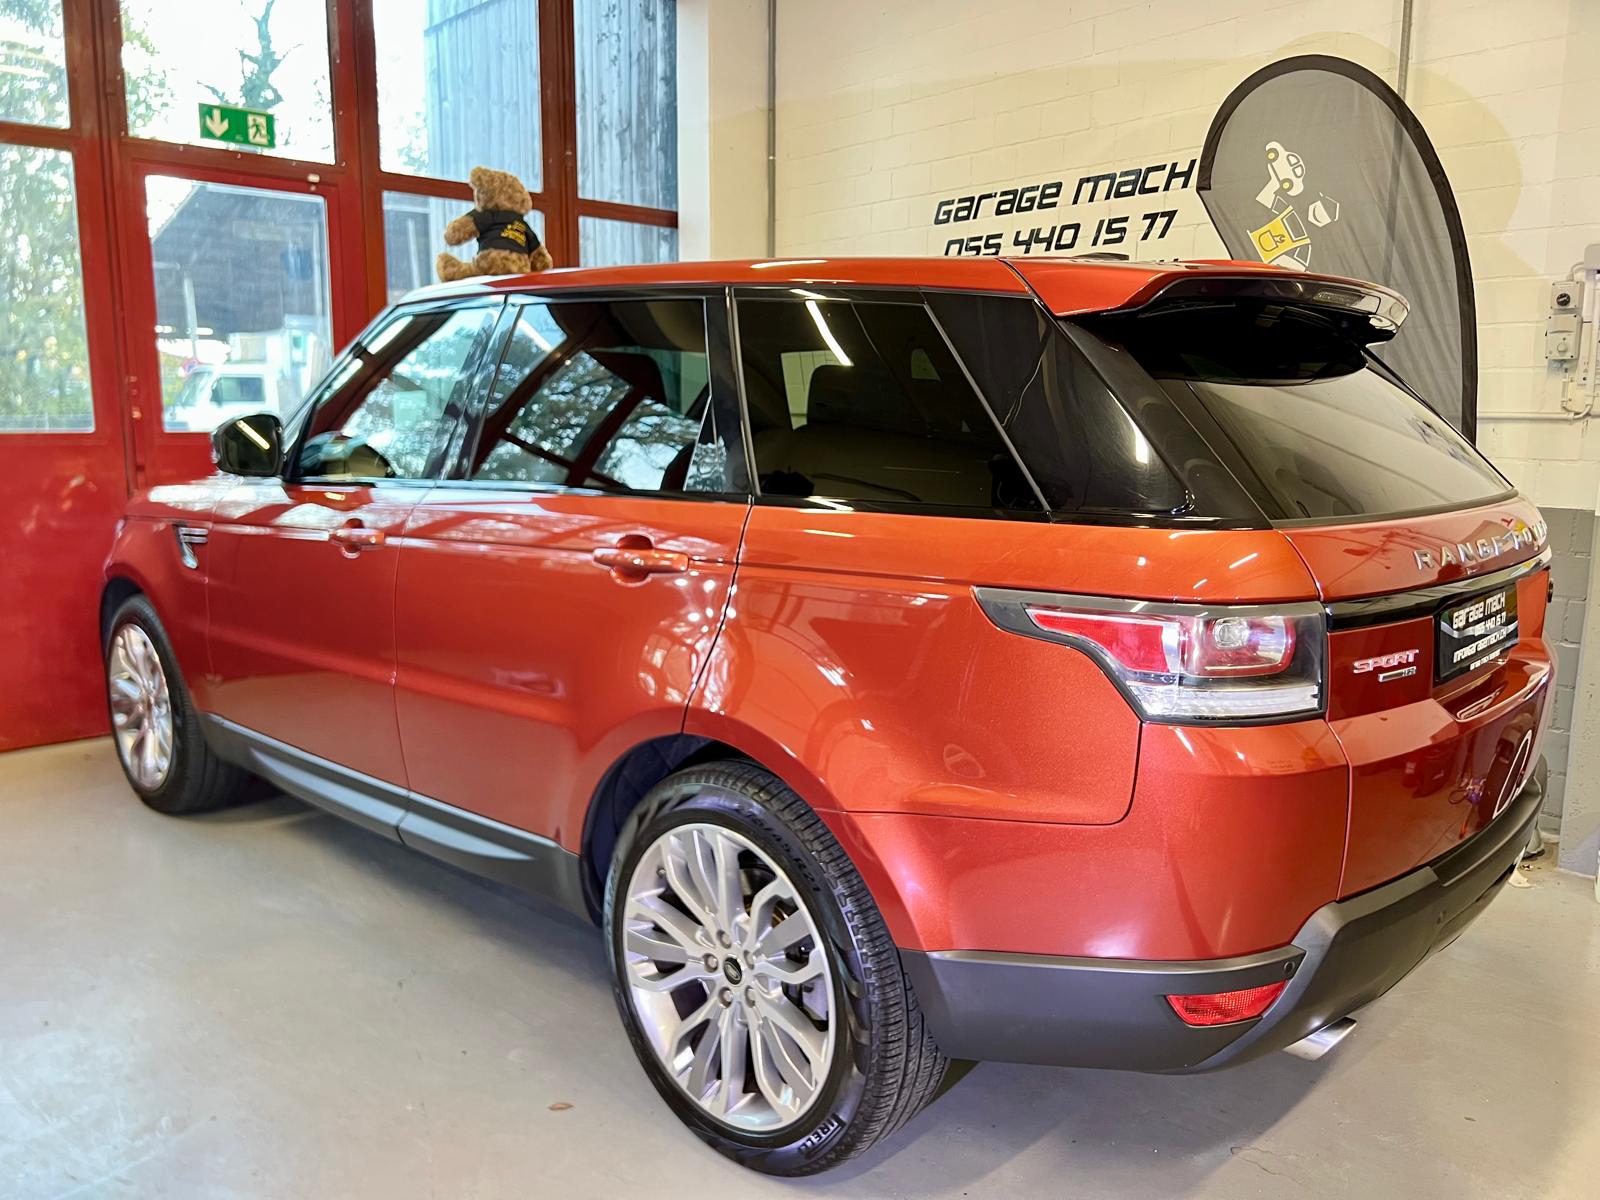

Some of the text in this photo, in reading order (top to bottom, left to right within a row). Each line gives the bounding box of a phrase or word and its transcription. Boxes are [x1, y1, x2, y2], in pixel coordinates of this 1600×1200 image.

[1013, 222, 1082, 255] 440
[1091, 215, 1130, 248] 15
[1140, 209, 1179, 242] 77
[1413, 535, 1506, 571] RANGE
[1353, 648, 1420, 674] SPORT
